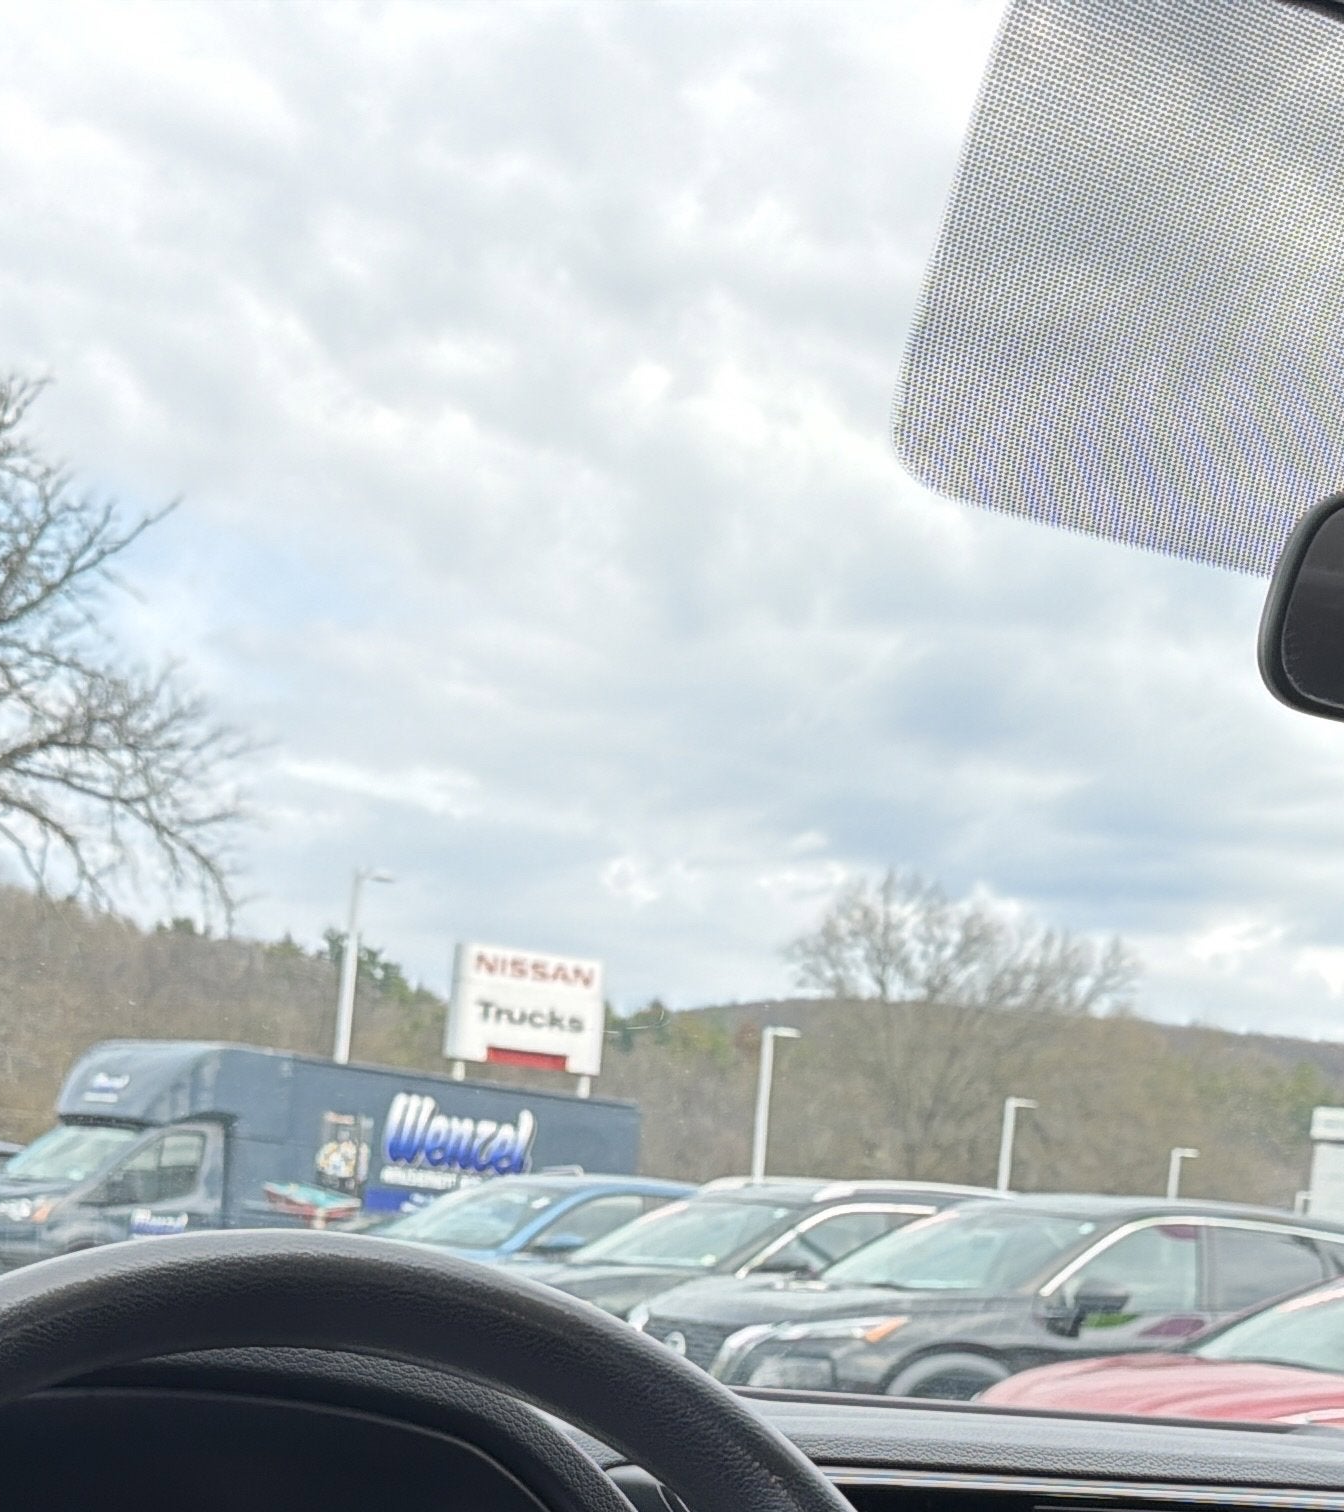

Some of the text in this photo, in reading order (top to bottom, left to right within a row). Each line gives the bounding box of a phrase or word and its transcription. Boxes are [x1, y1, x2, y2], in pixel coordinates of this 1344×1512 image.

[474, 951, 594, 989] NISSAN
[476, 1000, 585, 1034] Trucks
[383, 1091, 536, 1175] Wenzel
